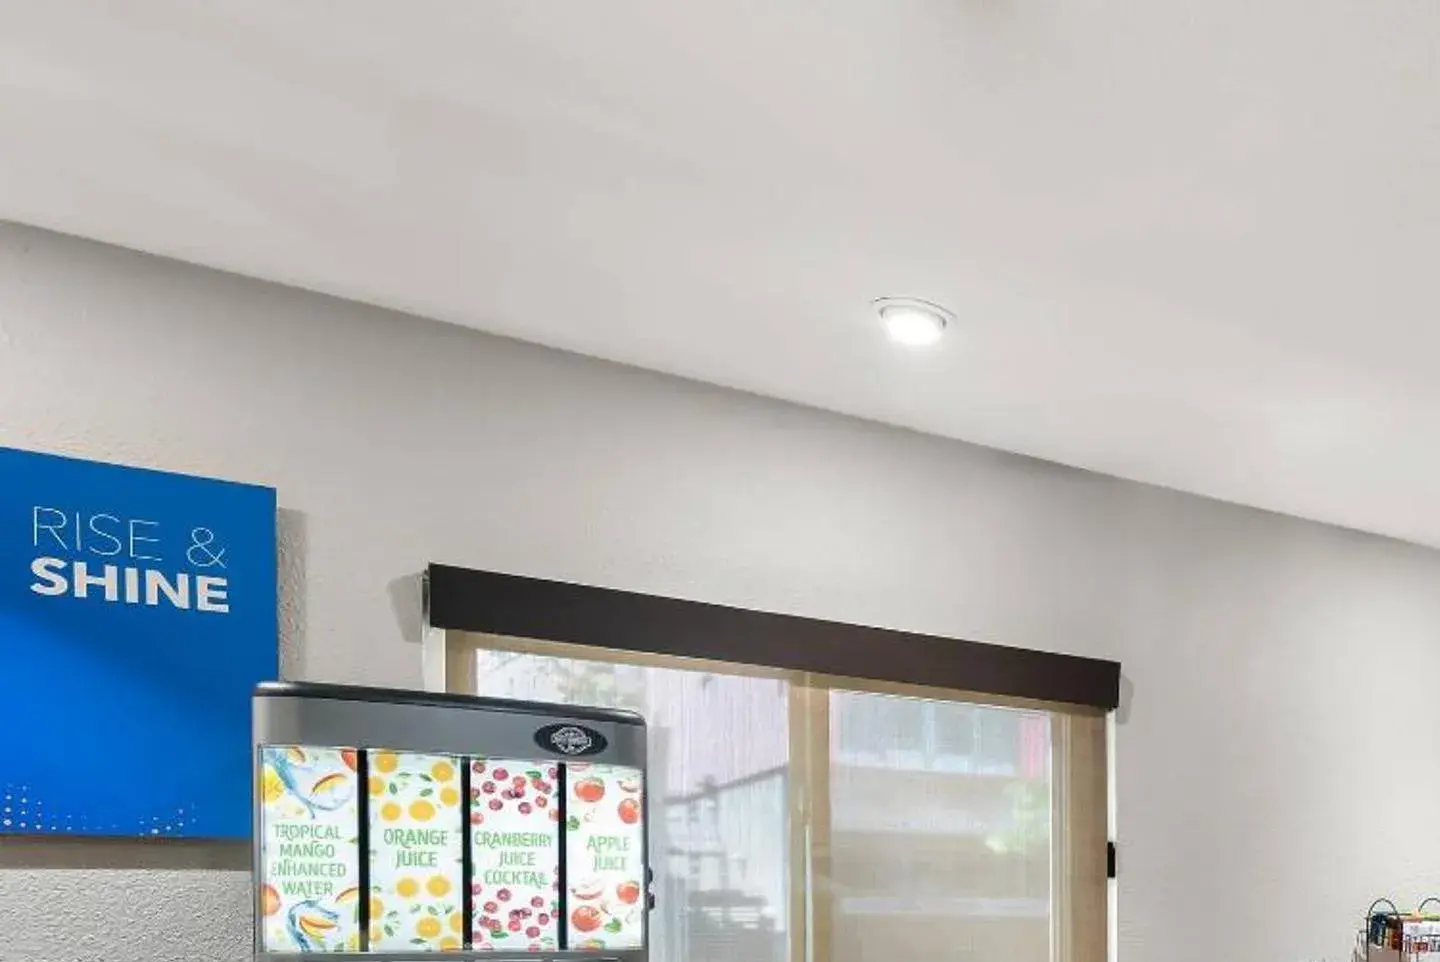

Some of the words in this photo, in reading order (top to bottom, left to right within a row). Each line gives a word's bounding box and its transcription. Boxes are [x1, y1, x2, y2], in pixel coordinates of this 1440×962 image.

[32, 505, 163, 562] RISE
[186, 526, 228, 569] &
[30, 555, 230, 613] SHINE
[273, 823, 342, 841] TROPICAL
[383, 828, 449, 848] ORANGE
[474, 830, 552, 848] CRANBERRY
[279, 843, 336, 858] MANGO
[586, 835, 632, 852] APPLE
[395, 849, 438, 869] JUICE
[498, 850, 537, 867] JUICE
[593, 855, 629, 872] JUICE
[271, 860, 347, 878] ENHANCED
[483, 869, 550, 888] COCKTAIL
[281, 880, 334, 898] WATER
